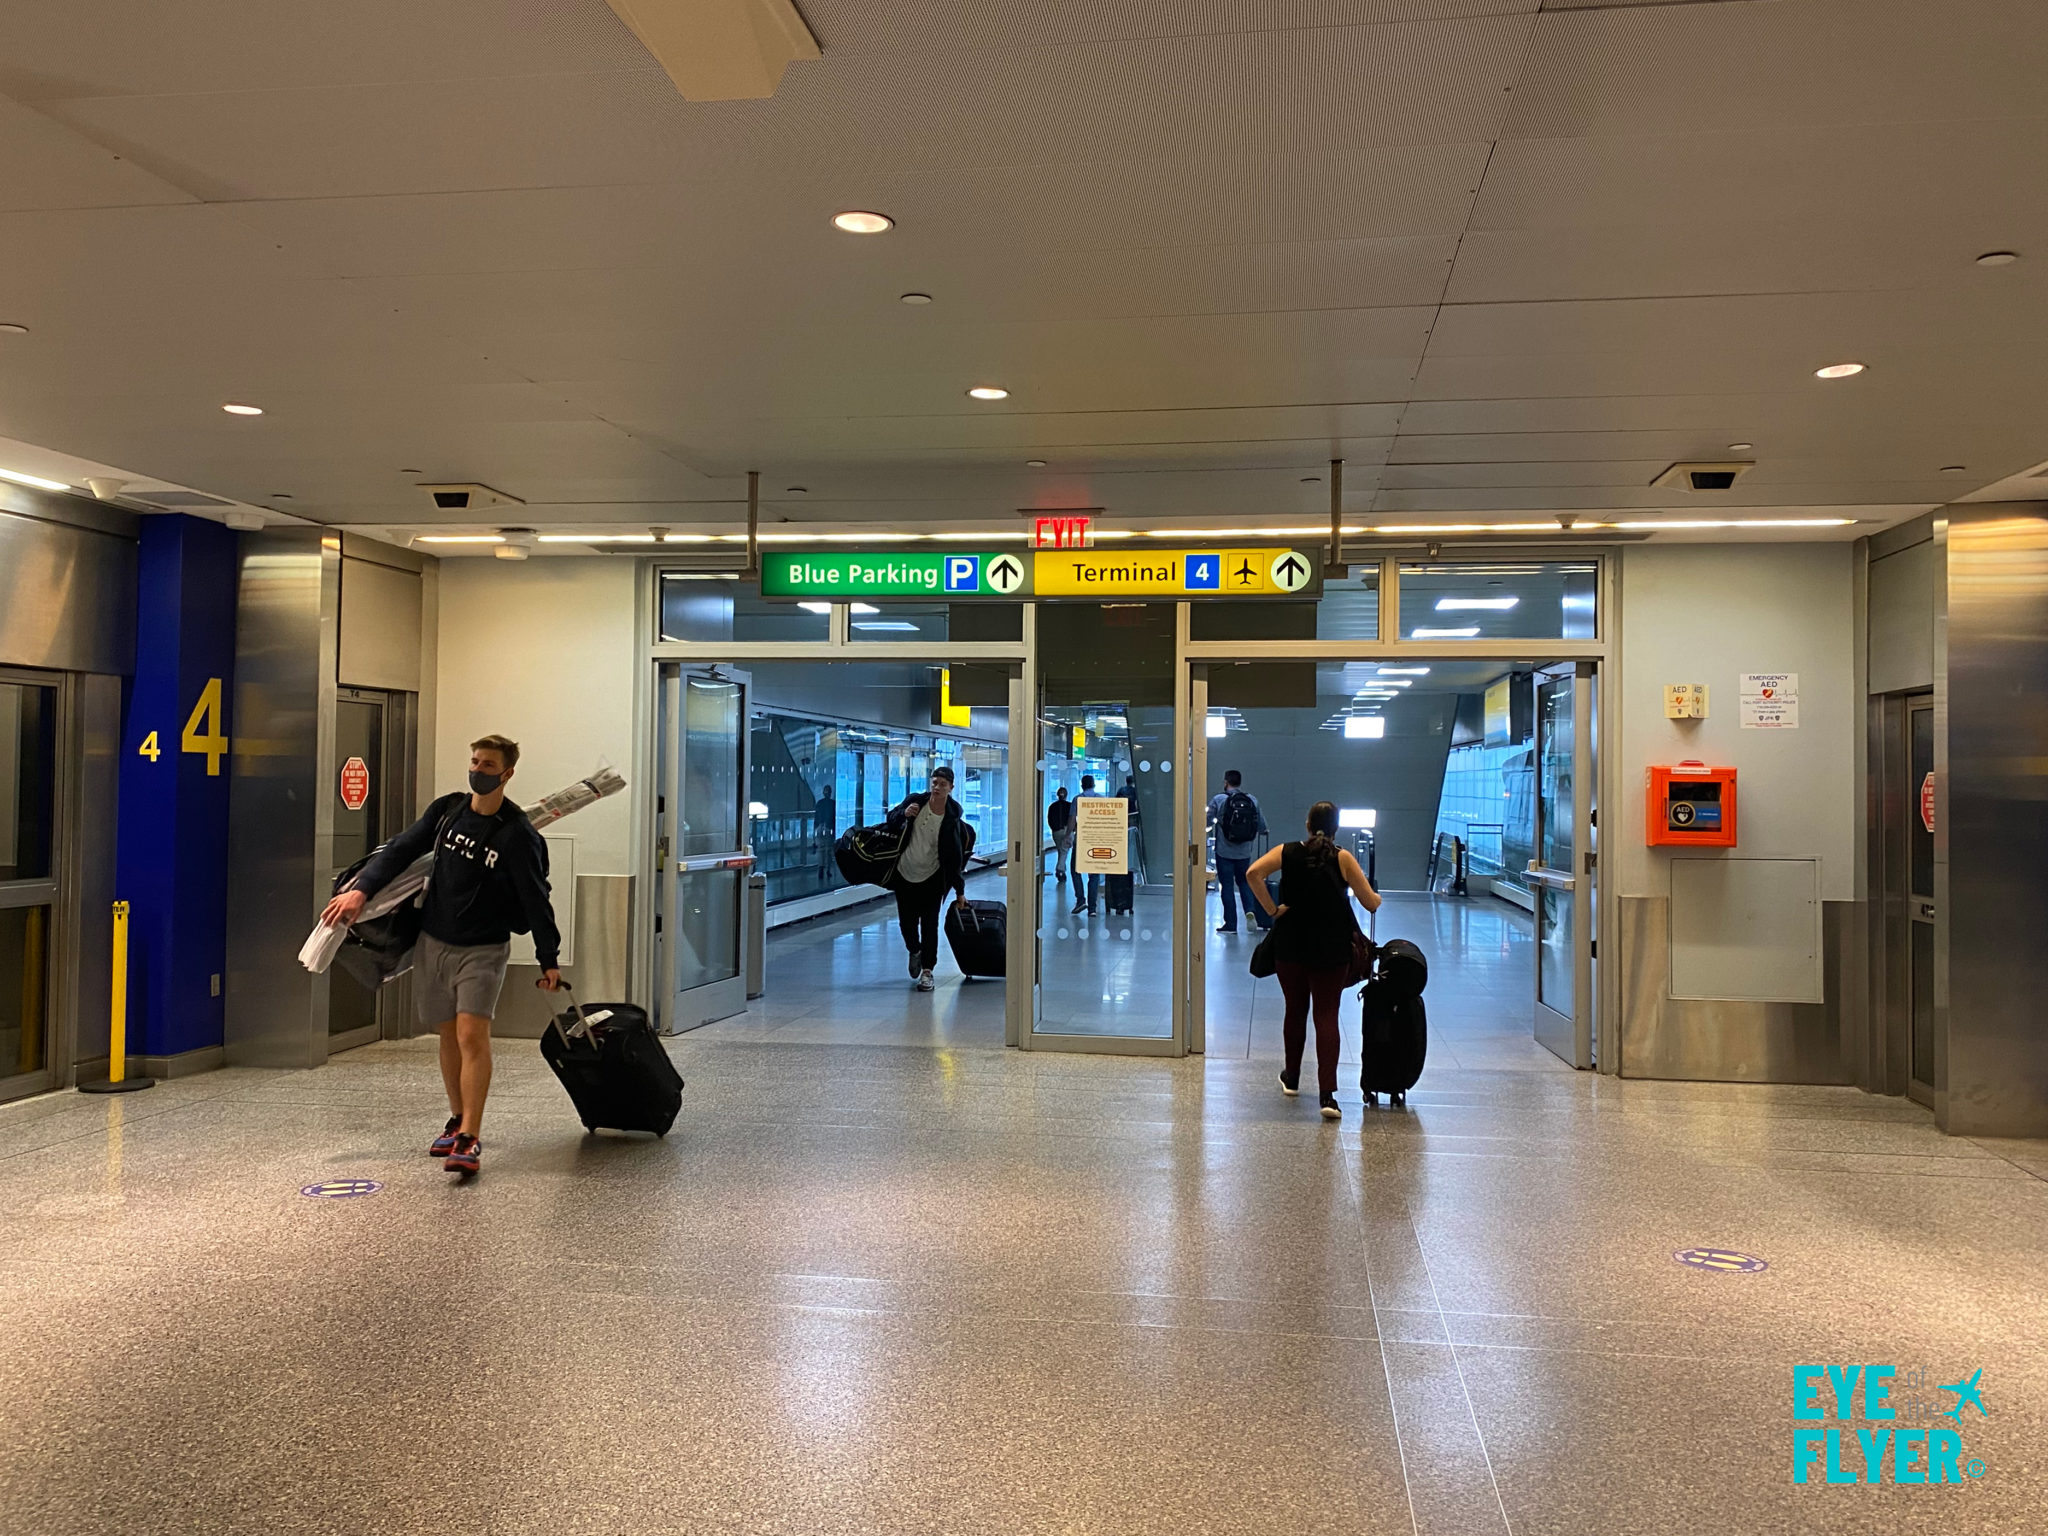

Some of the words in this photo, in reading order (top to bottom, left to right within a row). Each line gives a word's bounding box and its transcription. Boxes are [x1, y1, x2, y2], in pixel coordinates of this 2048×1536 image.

[1035, 518, 1089, 548] EXIT
[789, 564, 840, 584] Blue
[849, 564, 937, 589] Parking
[1072, 562, 1176, 582] Terminal
[1195, 563, 1210, 581] 4
[182, 677, 228, 776] 4
[139, 731, 160, 762] 4
